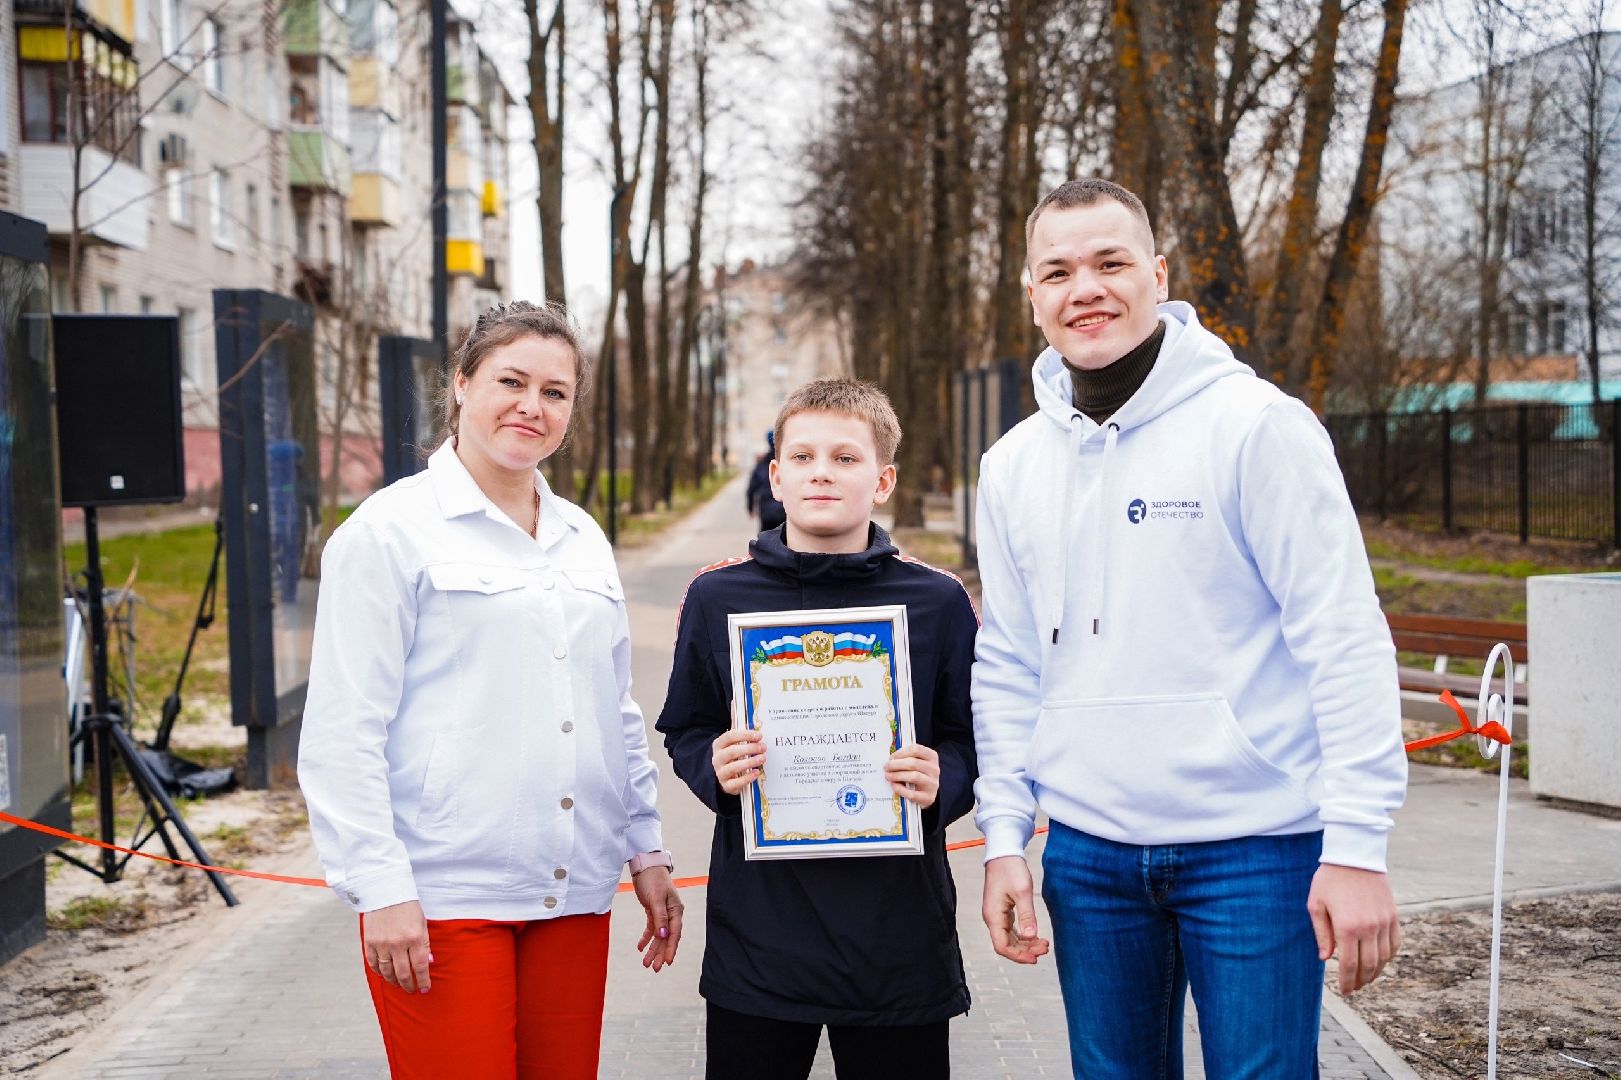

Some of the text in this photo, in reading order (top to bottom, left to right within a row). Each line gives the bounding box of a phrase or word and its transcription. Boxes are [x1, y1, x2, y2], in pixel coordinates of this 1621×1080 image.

[1150, 501, 1201, 509] ЗДОРОВОЕ
[1150, 511, 1204, 520] ОТЕЧЕСТВО
[781, 675, 863, 691] ГРАМОТА
[775, 732, 876, 746] НАГРАЖДАЕТСЯ
